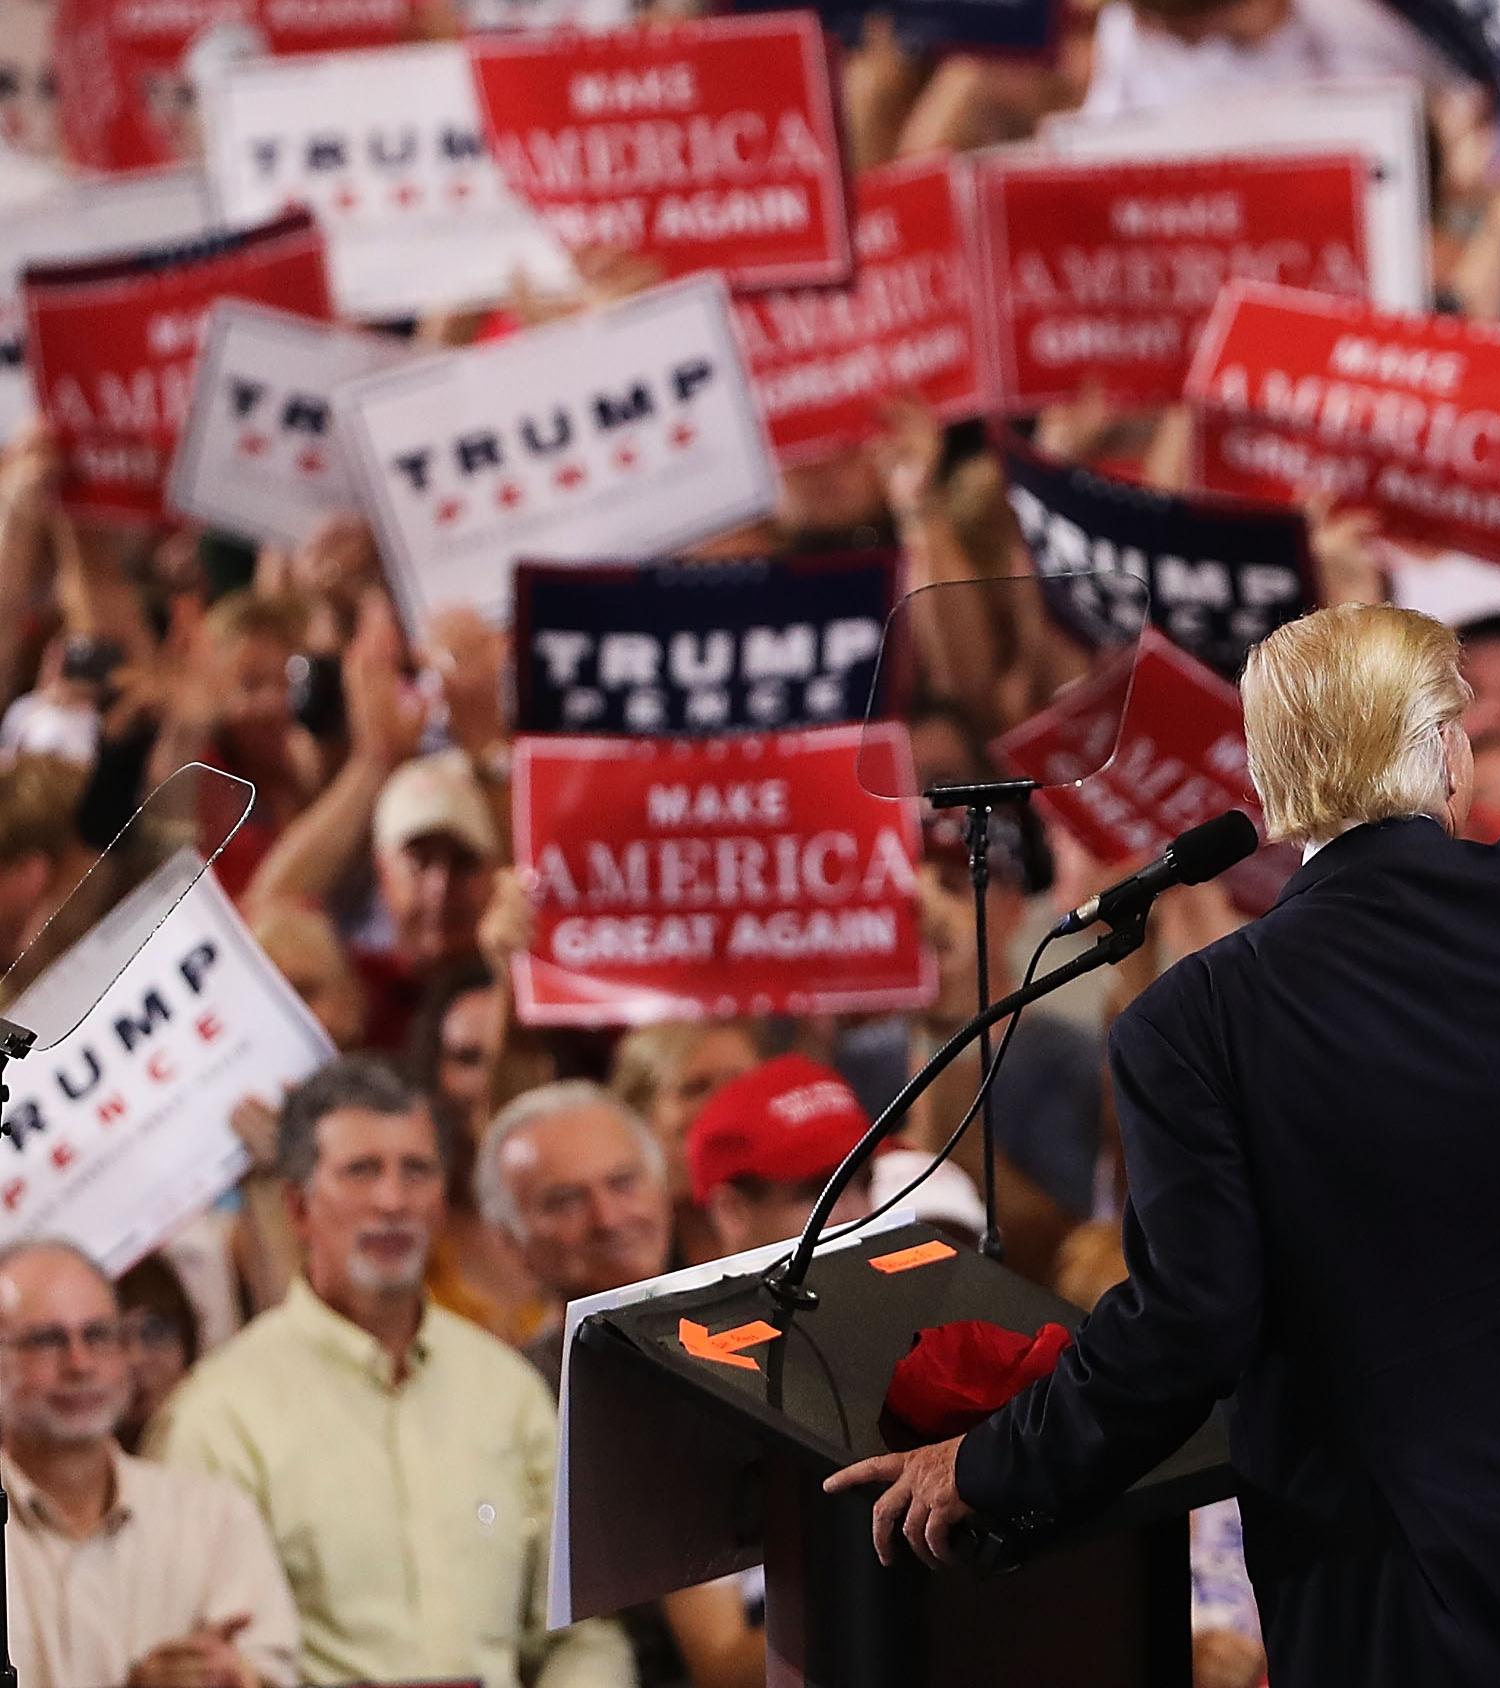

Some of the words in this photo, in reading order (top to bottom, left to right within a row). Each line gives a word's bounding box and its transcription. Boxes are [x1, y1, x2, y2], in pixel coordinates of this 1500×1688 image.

[250, 128, 484, 178] TRUM
[392, 356, 716, 490] TRUMP
[534, 617, 883, 690] TRUMP
[648, 780, 789, 826] MAKE
[534, 830, 920, 908] AMERICA
[552, 914, 716, 966] GREAT
[727, 908, 898, 960] AGAIN
[3, 938, 218, 1152] RUMP
